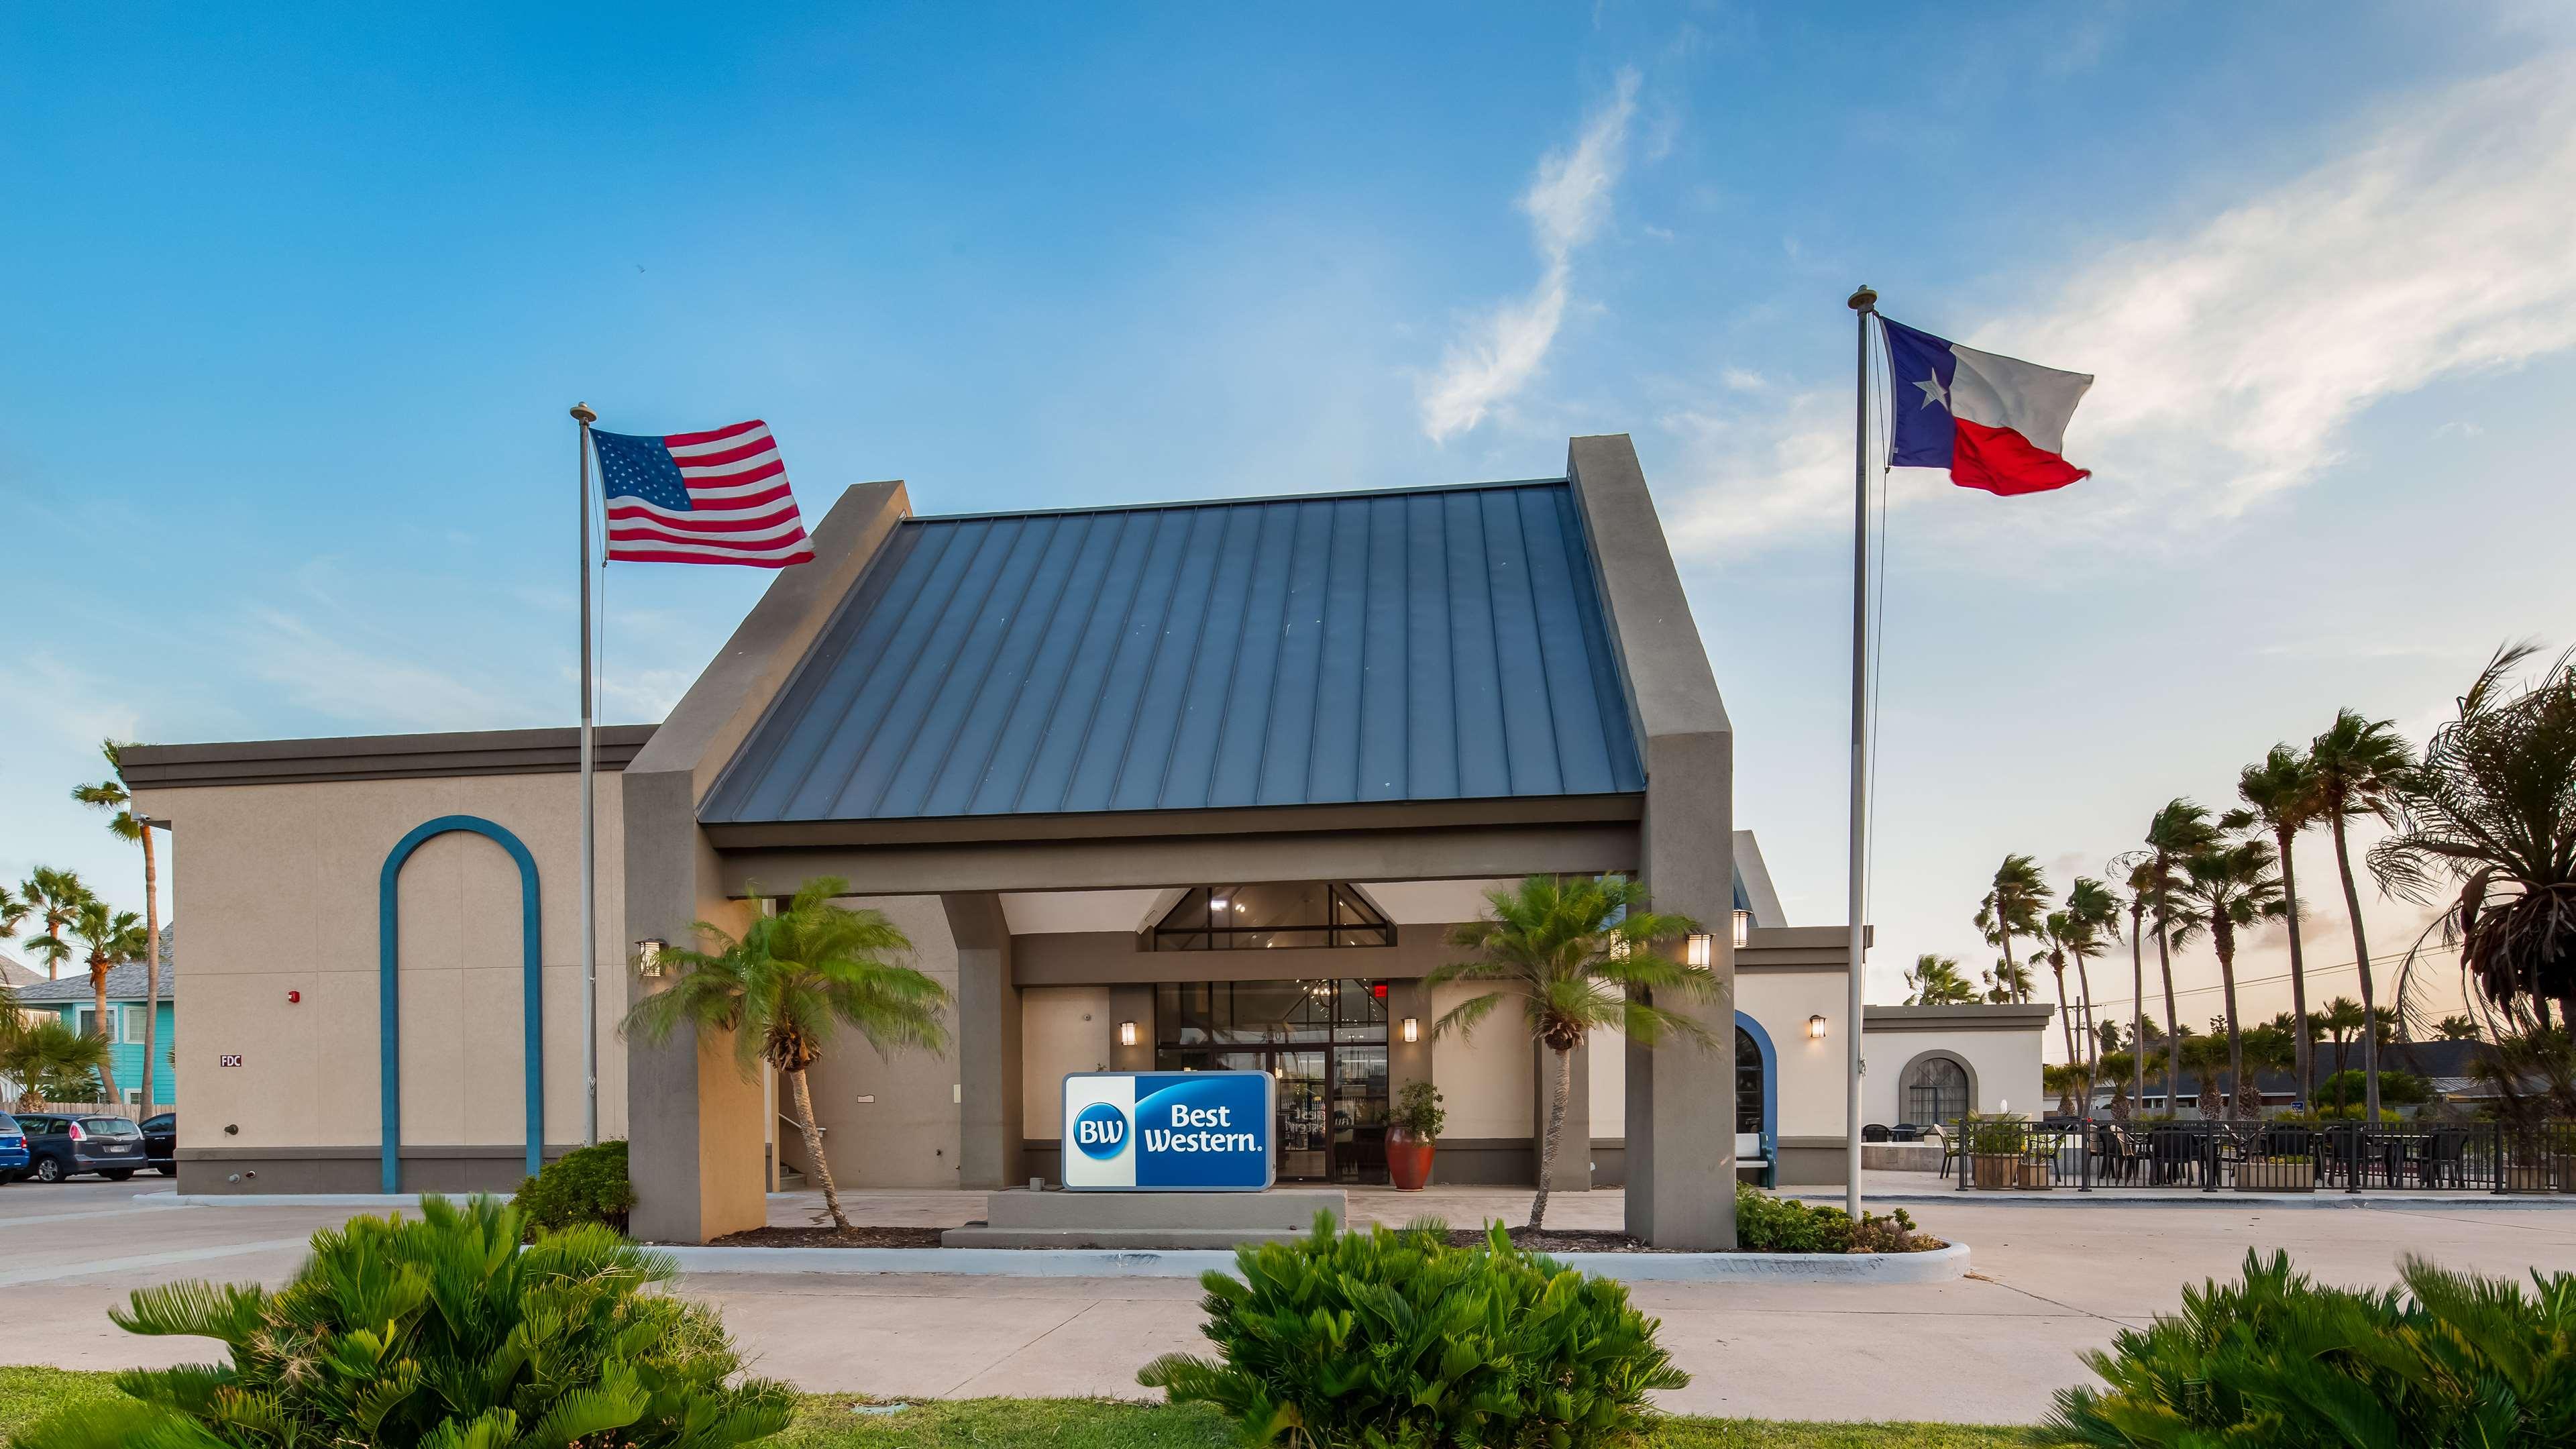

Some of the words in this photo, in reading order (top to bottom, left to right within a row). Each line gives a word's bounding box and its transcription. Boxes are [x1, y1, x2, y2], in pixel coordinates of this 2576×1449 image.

[221, 1055, 241, 1067] FDC
[1171, 1104, 1231, 1128] Best
[1080, 1120, 1124, 1144] BW
